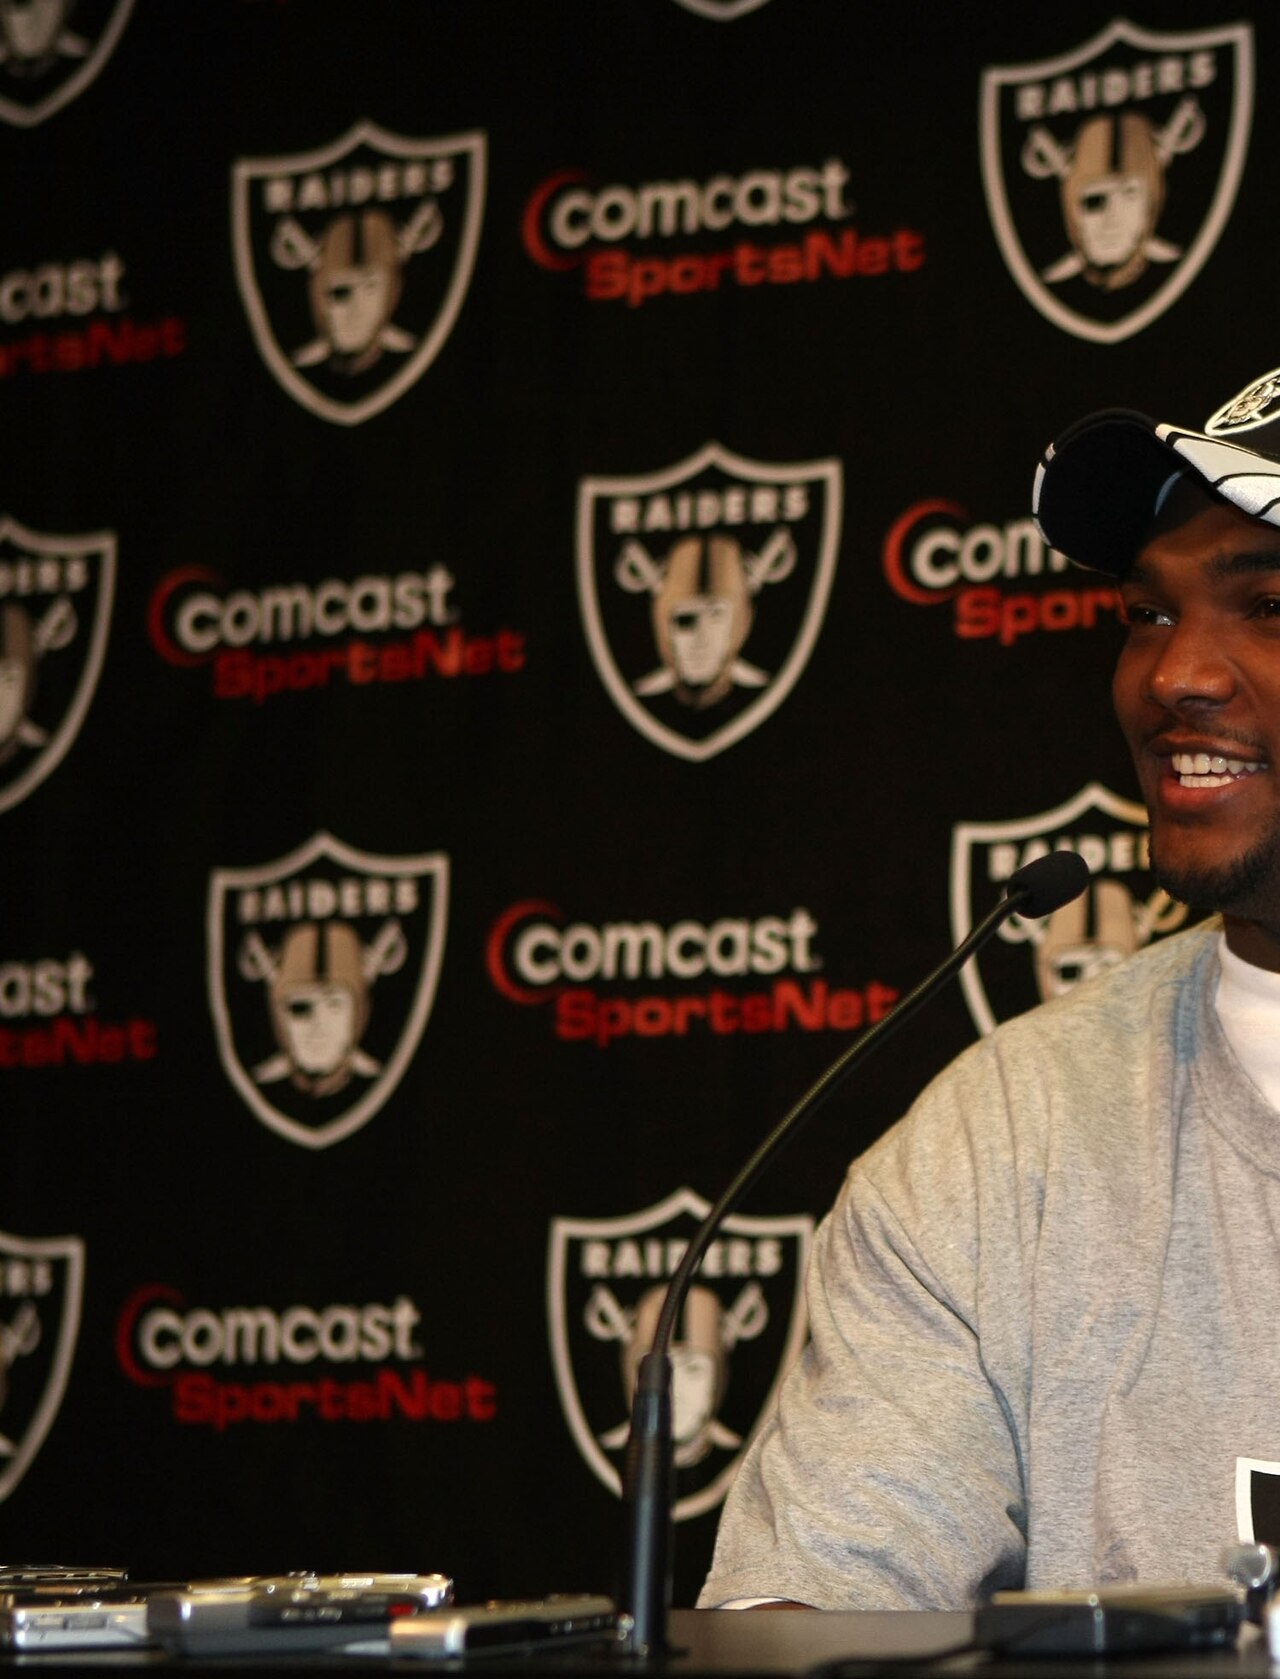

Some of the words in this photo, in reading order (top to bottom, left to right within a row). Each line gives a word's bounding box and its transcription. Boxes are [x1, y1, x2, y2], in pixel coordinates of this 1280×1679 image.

[1015, 48, 1218, 123] RAIDERS
[263, 157, 456, 215] RAIDERS
[586, 229, 925, 306] SportsNet
[610, 483, 811, 535] RAIDERS
[214, 627, 527, 702] SportsNet
[236, 876, 420, 926] RAIDERS
[555, 979, 900, 1047] SportsNet
[174, 1369, 497, 1431] SportsNet
